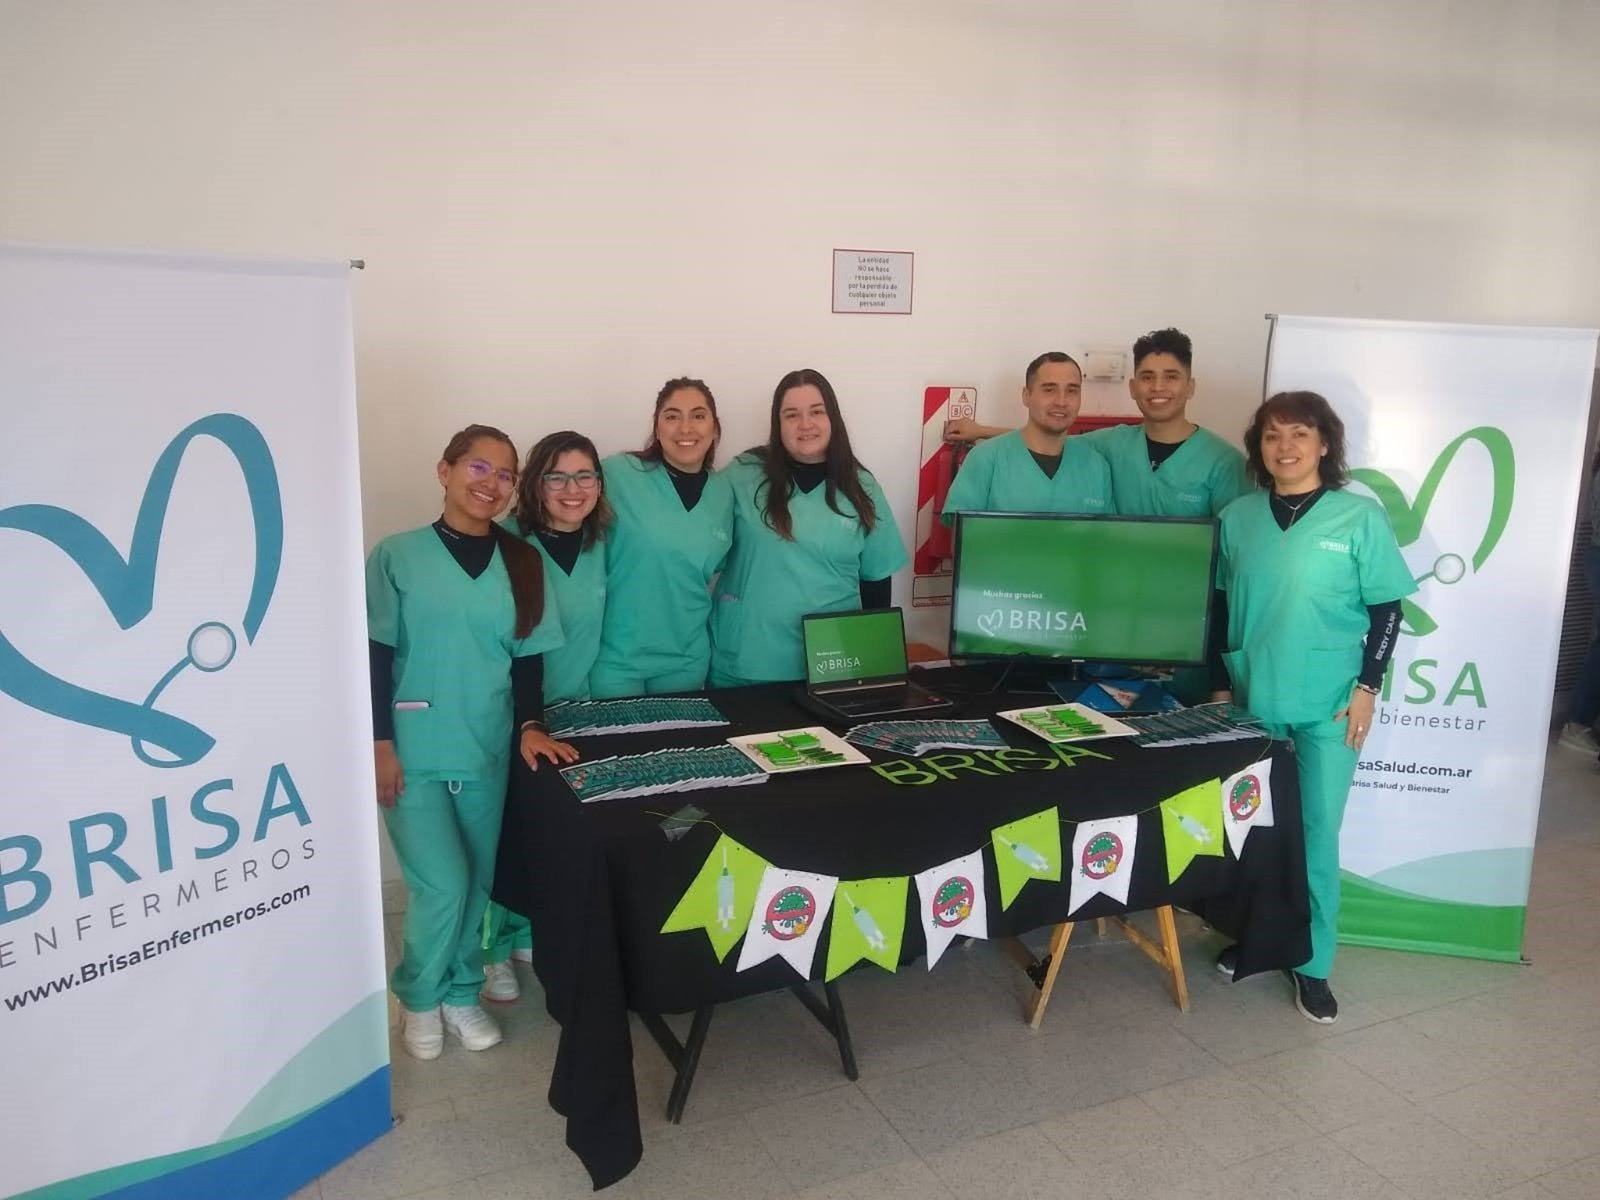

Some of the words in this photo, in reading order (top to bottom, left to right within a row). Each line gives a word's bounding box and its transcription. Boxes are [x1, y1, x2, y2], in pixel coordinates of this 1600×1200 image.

[1009, 609, 1087, 631] BRISA
[829, 657, 861, 670] BRISA
[1381, 657, 1488, 709] ISA
[1379, 707, 1487, 731] bienestar
[869, 742, 1114, 785] BRISA
[1357, 759, 1473, 779] saSalud.com.ar
[1373, 781, 1398, 790] Salud
[1399, 784, 1406, 792] y
[1407, 784, 1451, 794] Bienestar
[0, 762, 312, 925] BRISA
[0, 839, 315, 968] ENFERMEROS
[4, 884, 311, 1012] www.BrisaEnfermeros.com
